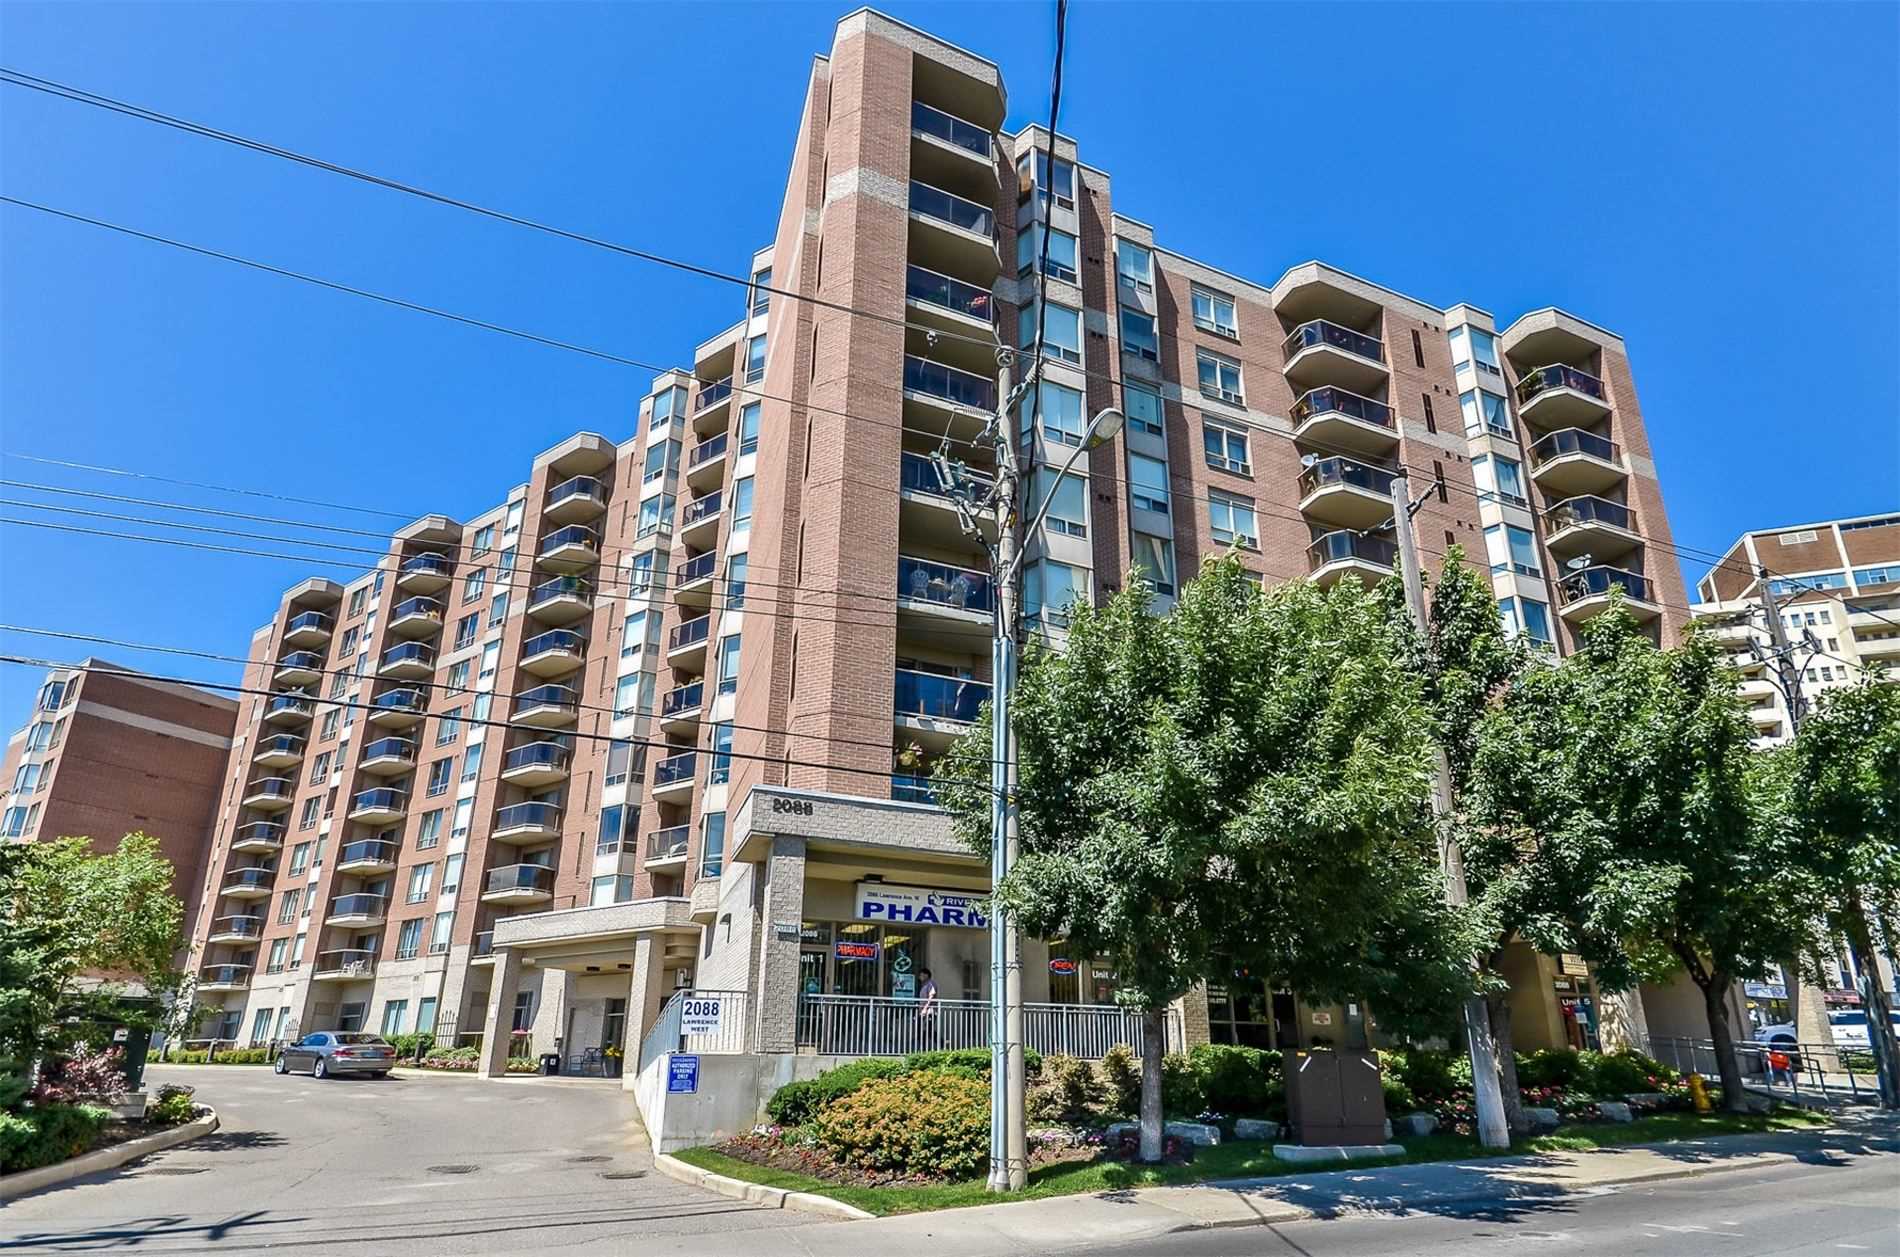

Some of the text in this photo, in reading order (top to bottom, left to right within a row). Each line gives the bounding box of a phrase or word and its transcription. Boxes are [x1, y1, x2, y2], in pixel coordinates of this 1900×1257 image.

[773, 798, 813, 815] 2088
[838, 944, 874, 956] PHARMACY
[1092, 969, 1109, 979] Unit
[684, 1001, 719, 1016] 2088
